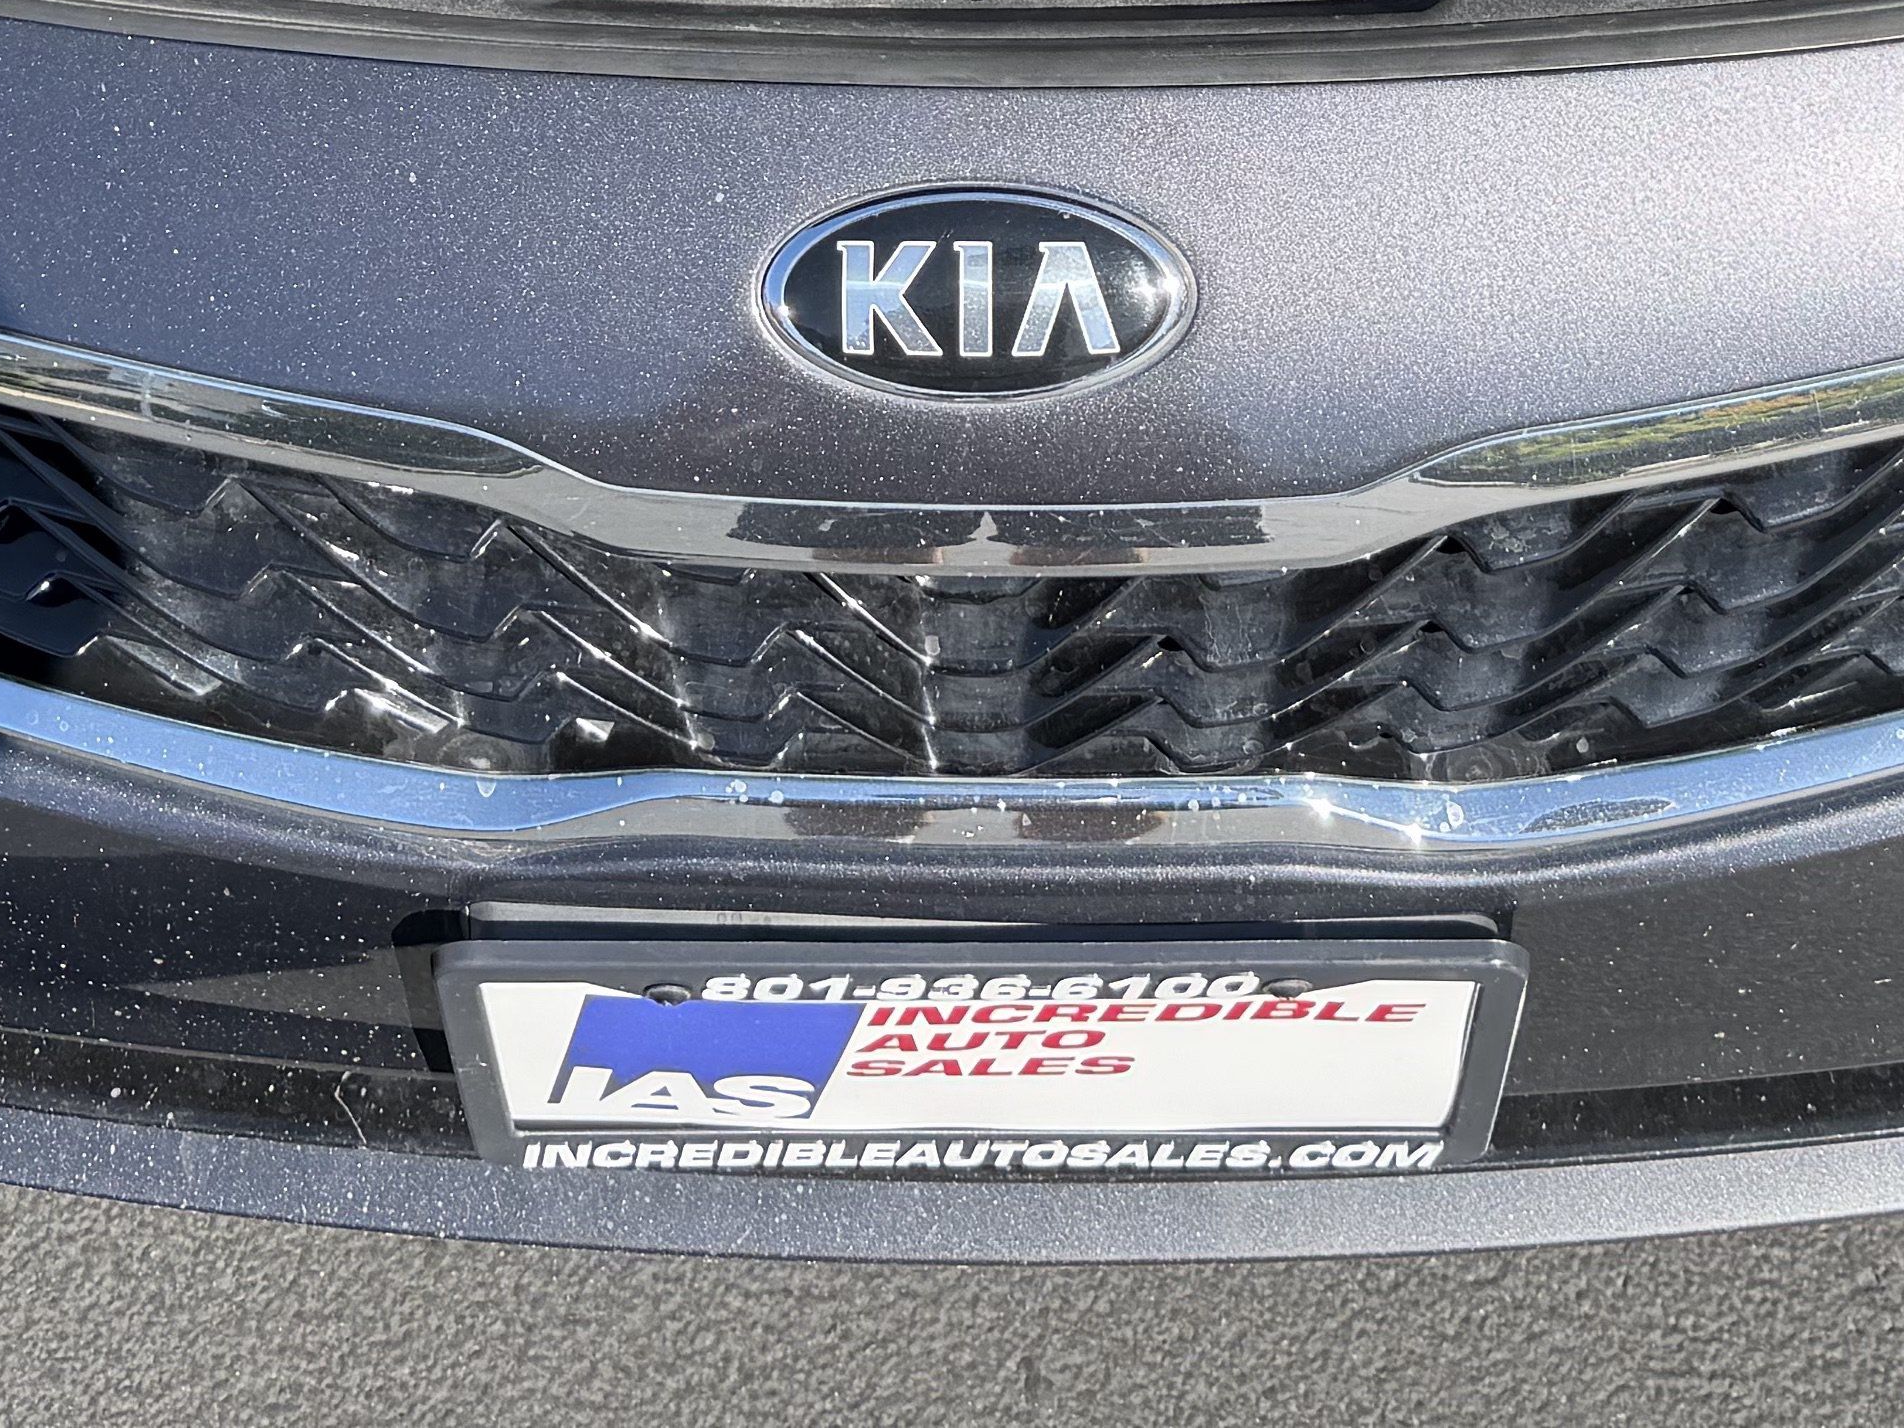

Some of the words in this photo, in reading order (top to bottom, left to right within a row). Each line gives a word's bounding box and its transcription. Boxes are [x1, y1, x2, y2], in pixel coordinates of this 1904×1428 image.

[836, 240, 1122, 358] KIA
[701, 971, 1259, 1002] 801-936-6100
[867, 999, 1427, 1026] INCREDIBLE
[856, 1029, 1107, 1053] AUTO
[846, 1055, 1137, 1077] SALES
[560, 1065, 816, 1119] IAS
[522, 1138, 1445, 1171] INCREDIBLEAUTOSALES.COM
